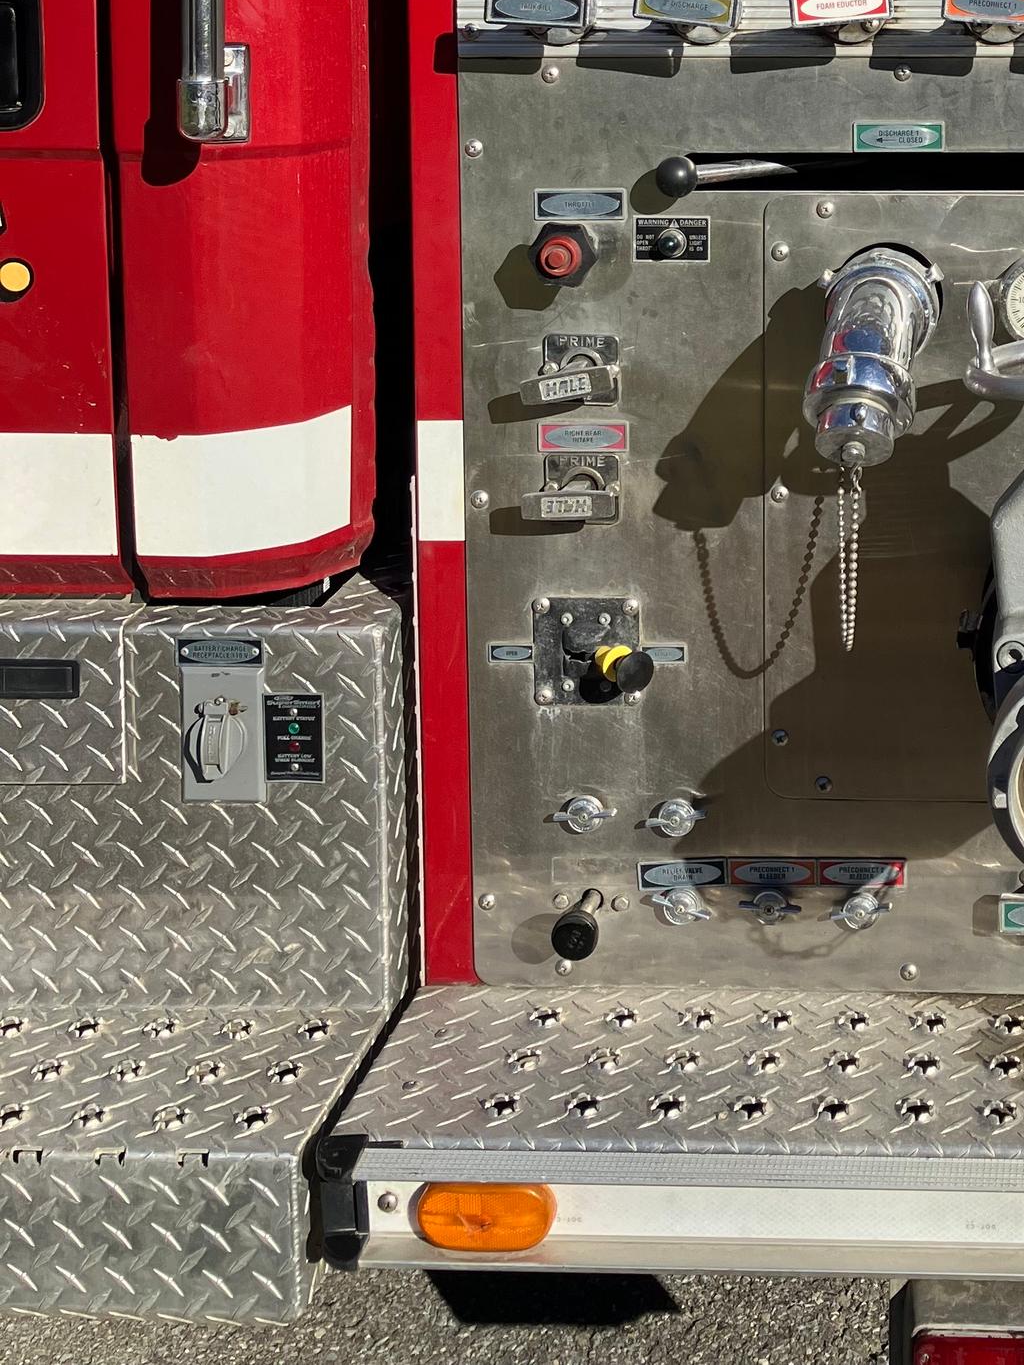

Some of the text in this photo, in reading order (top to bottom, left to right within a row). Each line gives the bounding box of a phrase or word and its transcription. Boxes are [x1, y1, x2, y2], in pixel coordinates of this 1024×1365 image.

[670, 0, 709, 11] DISCHARGE
[816, 0, 867, 10] FOAM EDUCTOR
[969, 0, 1012, 9] PRECONNECT
[559, 337, 605, 348] PRIME
[559, 456, 606, 467] PRIME
[685, 866, 703, 874] VALVE
